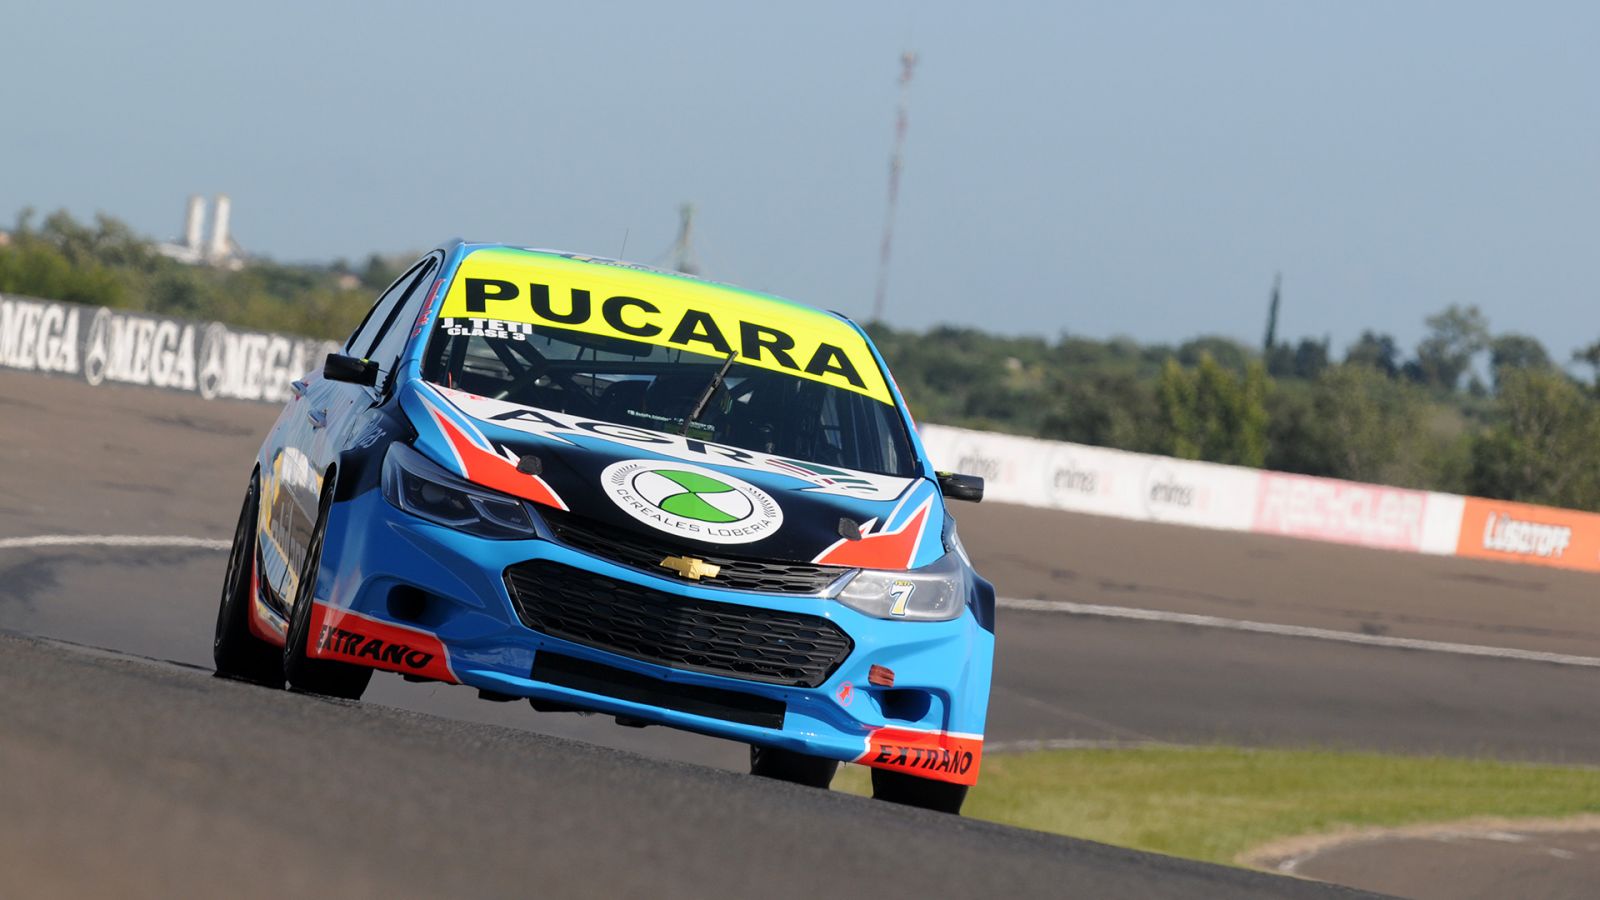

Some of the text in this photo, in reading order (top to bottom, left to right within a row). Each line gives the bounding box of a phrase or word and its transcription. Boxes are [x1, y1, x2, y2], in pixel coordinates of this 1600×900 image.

[441, 317, 533, 335] J. TETI
[447, 328, 526, 341] CLASE 3
[464, 277, 869, 391] PUCARA
[616, 488, 700, 533] CEREALES
[889, 582, 915, 616] 7
